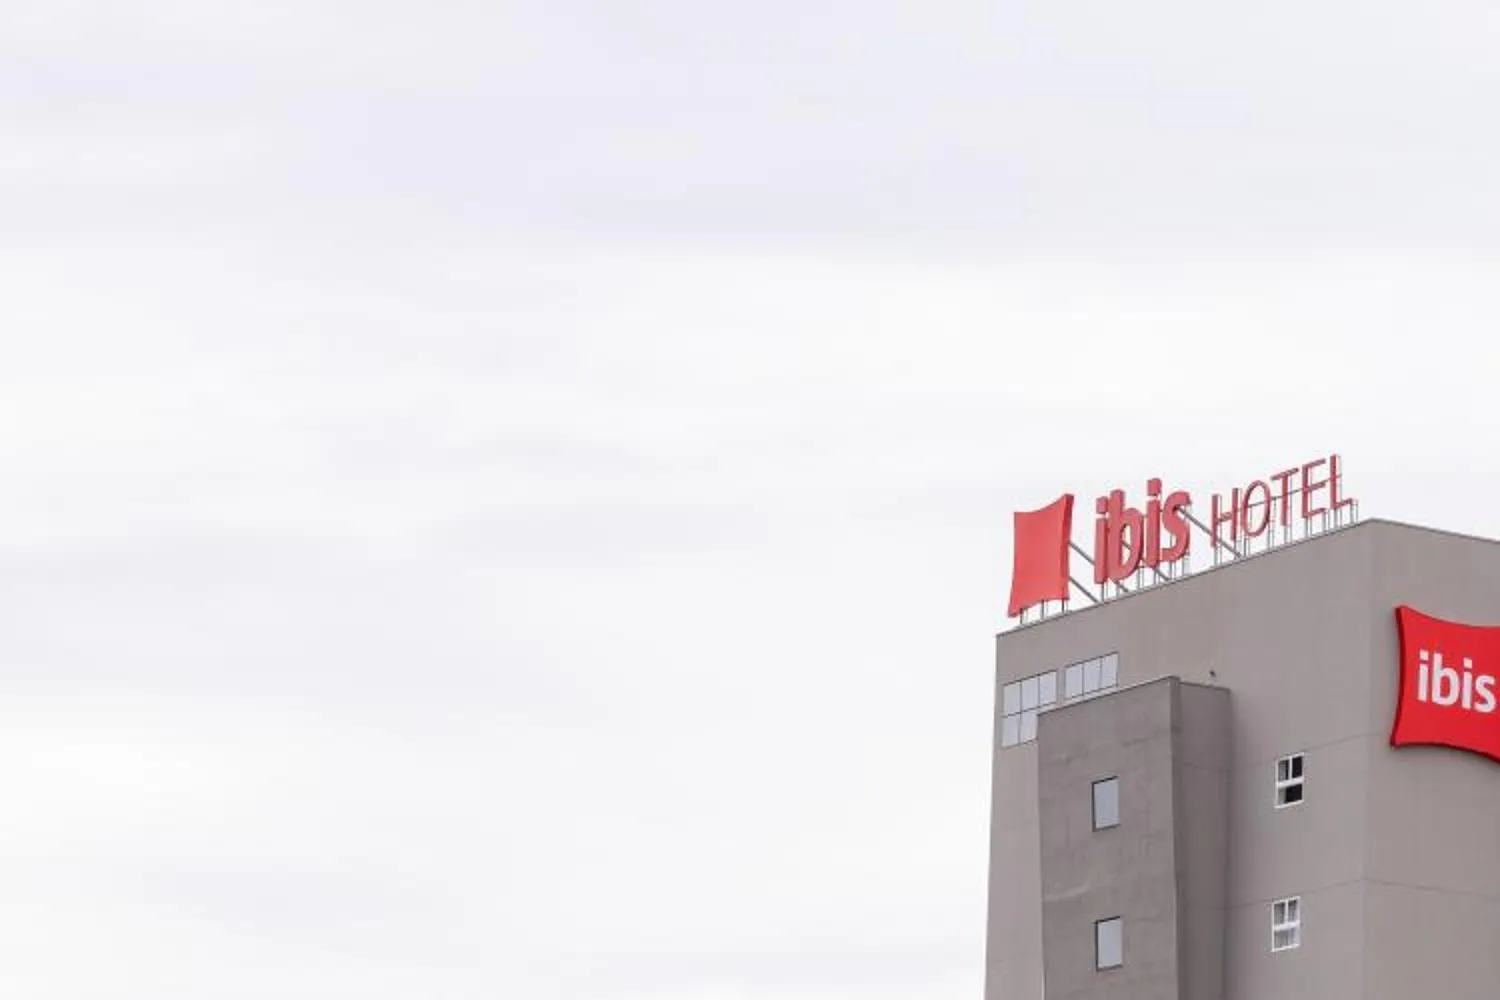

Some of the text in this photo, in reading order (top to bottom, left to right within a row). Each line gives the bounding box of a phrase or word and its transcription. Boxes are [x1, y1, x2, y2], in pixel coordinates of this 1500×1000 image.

[1094, 454, 1353, 584] ibis HOTEL
[1418, 650, 1497, 713] ibis
